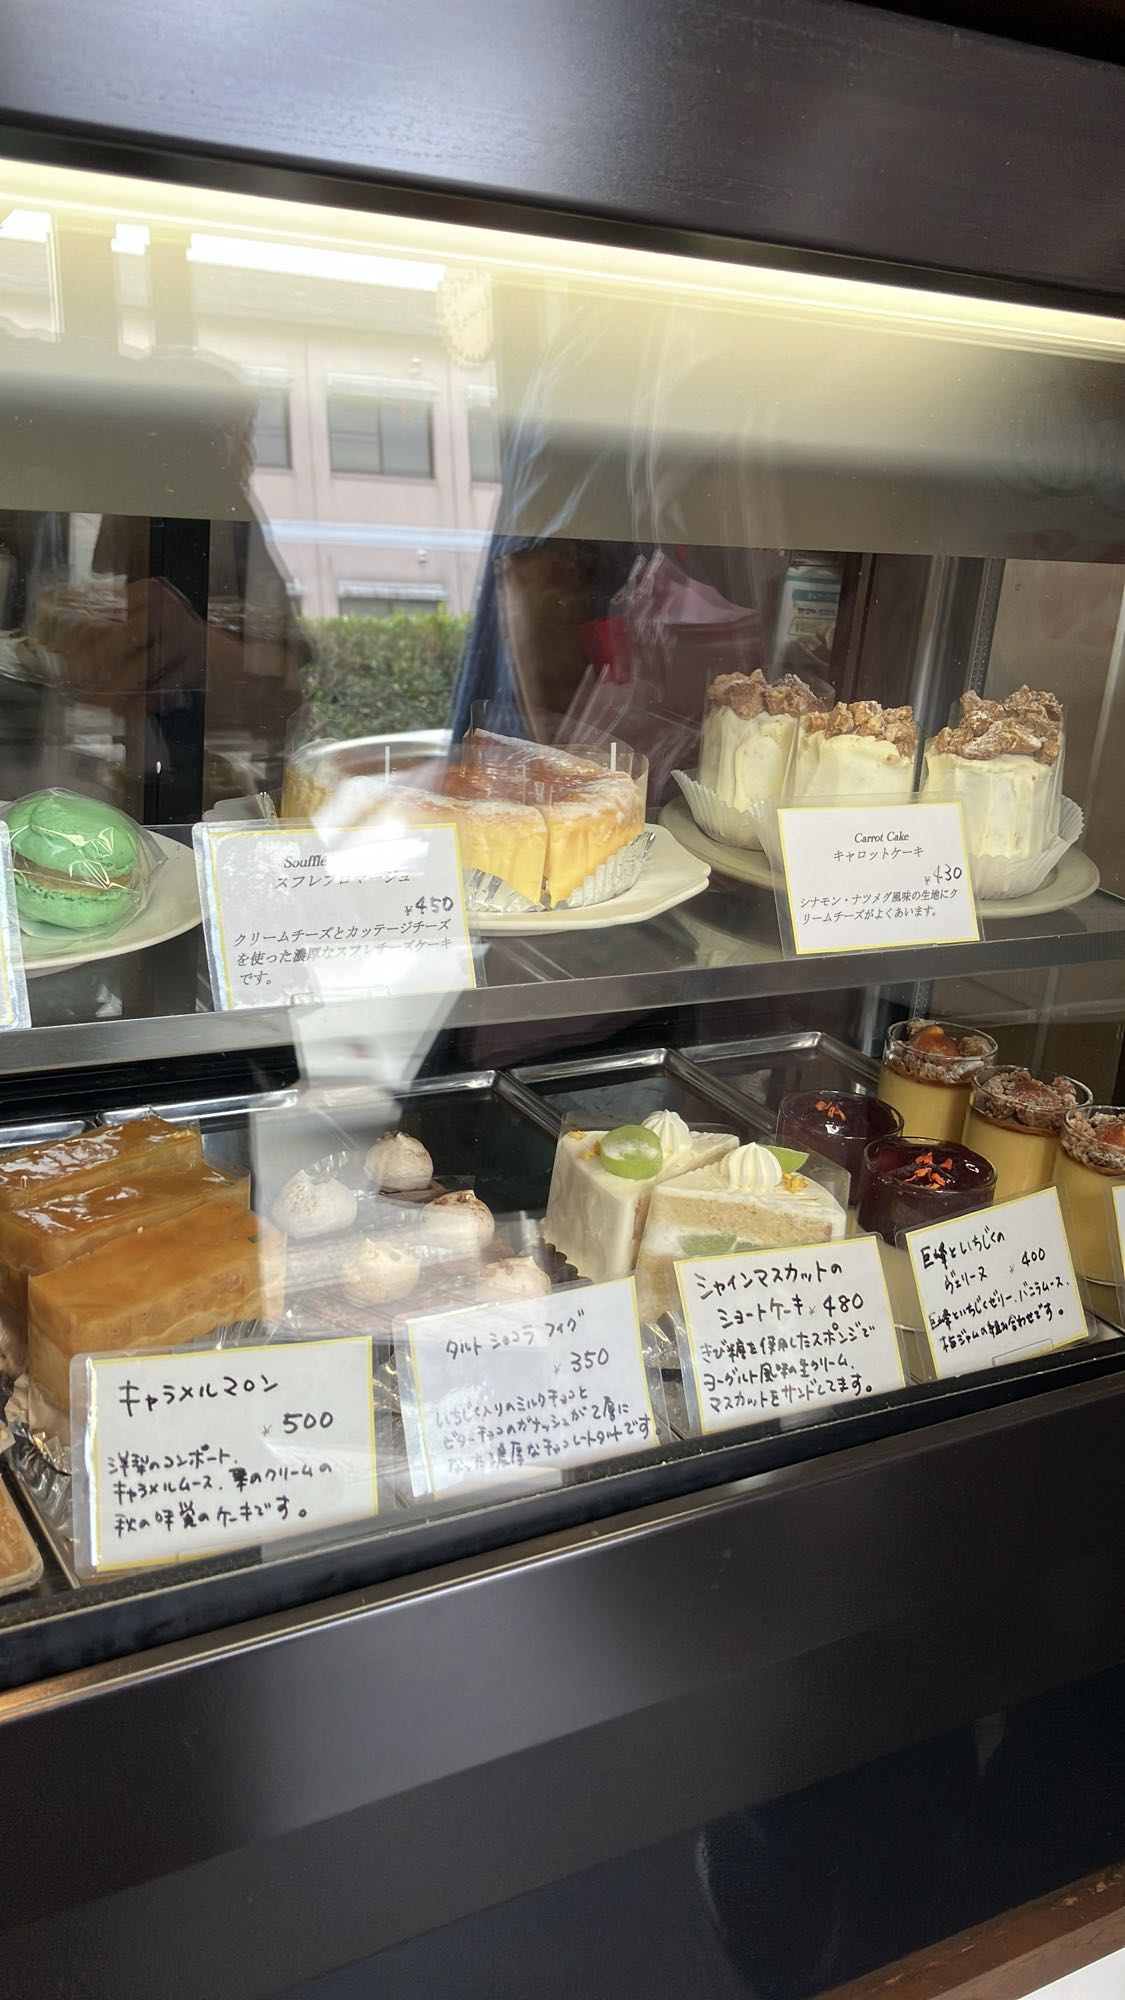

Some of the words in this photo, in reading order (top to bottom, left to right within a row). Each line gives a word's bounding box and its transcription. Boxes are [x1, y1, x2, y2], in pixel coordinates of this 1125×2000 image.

[854, 832, 884, 844] Carrot
[886, 831, 910, 843] Cake
[833, 847, 924, 863] キャロットケーキ
[800, 888, 959, 909] シナモン・ナツメグ風味の生地にク
[803, 905, 937, 926] リームチーズがよくあいます。
[233, 918, 452, 947] クリームチーズとカッテージチーズ
[240, 970, 273, 986] です。
[1021, 1247, 1046, 1267] 400
[694, 1260, 843, 1300] シャインマスカットの
[717, 1293, 804, 1329] ショートケーキ
[822, 1292, 864, 1318] 480
[446, 1336, 482, 1360] タルト
[570, 1347, 610, 1373] 350
[118, 1374, 279, 1418] キャラメルマロン
[282, 1411, 334, 1434] 500
